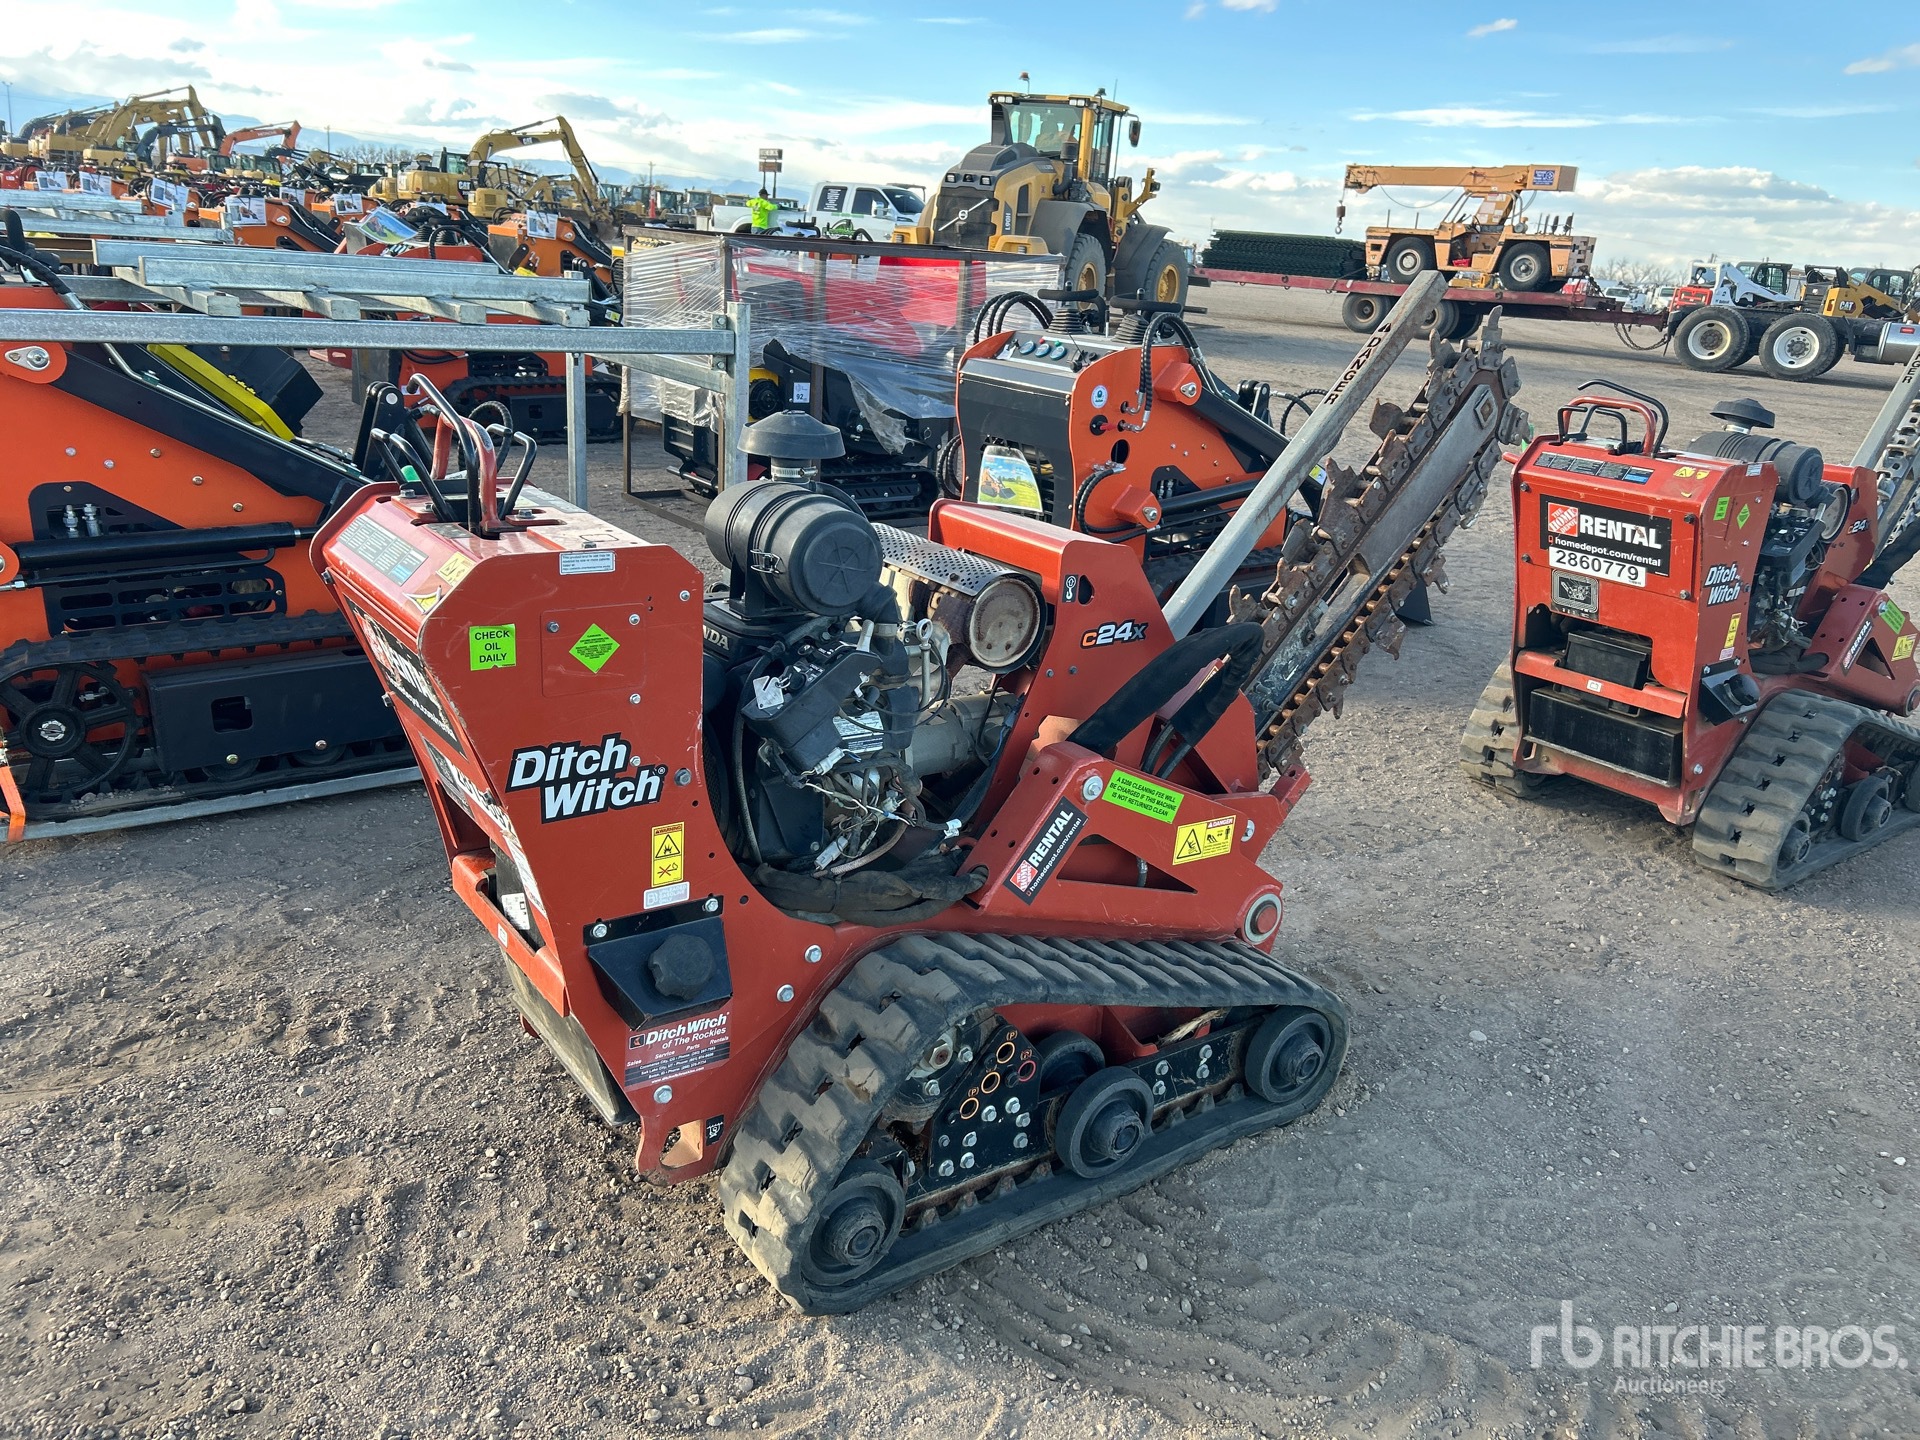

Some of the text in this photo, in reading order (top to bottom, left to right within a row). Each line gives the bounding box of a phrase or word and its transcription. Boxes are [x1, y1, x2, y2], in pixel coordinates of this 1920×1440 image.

[522, 137, 533, 145] CAT
[458, 181, 470, 190] CAT
[1839, 301, 1854, 313] CAT
[1324, 337, 1381, 404] DANGER
[1548, 508, 1578, 532] HOME
[1580, 513, 1662, 549] RENTAL
[1555, 536, 1661, 567] homedepot.com/rental
[1556, 549, 1639, 581] 2860779
[1705, 563, 1737, 586] Ditch
[1708, 582, 1741, 605] Witch
[474, 630, 510, 641] CHECK
[484, 642, 502, 651] OIL
[1850, 620, 1871, 654] RENTAL
[479, 652, 507, 663] DAILY
[511, 738, 627, 788] Ditch
[545, 769, 661, 819] Witch
[1117, 784, 1140, 798] CHARGED
[1145, 795, 1156, 804] THIS
[1156, 798, 1177, 811] MACHINE
[1132, 782, 1156, 795] CLEANING
[1155, 789, 1165, 798] FEE
[1164, 793, 1176, 803] WILL
[1117, 793, 1128, 801] NOT
[1128, 797, 1153, 811] RETURNED
[1152, 806, 1169, 816] CLEAN
[659, 825, 682, 833] WARNING
[1212, 818, 1234, 827] DANGER
[1028, 810, 1074, 868] RENTAL
[1030, 817, 1082, 892] homedepot.com/rental
[646, 1013, 727, 1045] Ditch Witch
[662, 1026, 727, 1049] of The Rockies
[627, 1059, 642, 1067] Sales
[655, 1050, 675, 1059] Service
[686, 1043, 700, 1051] Parts
